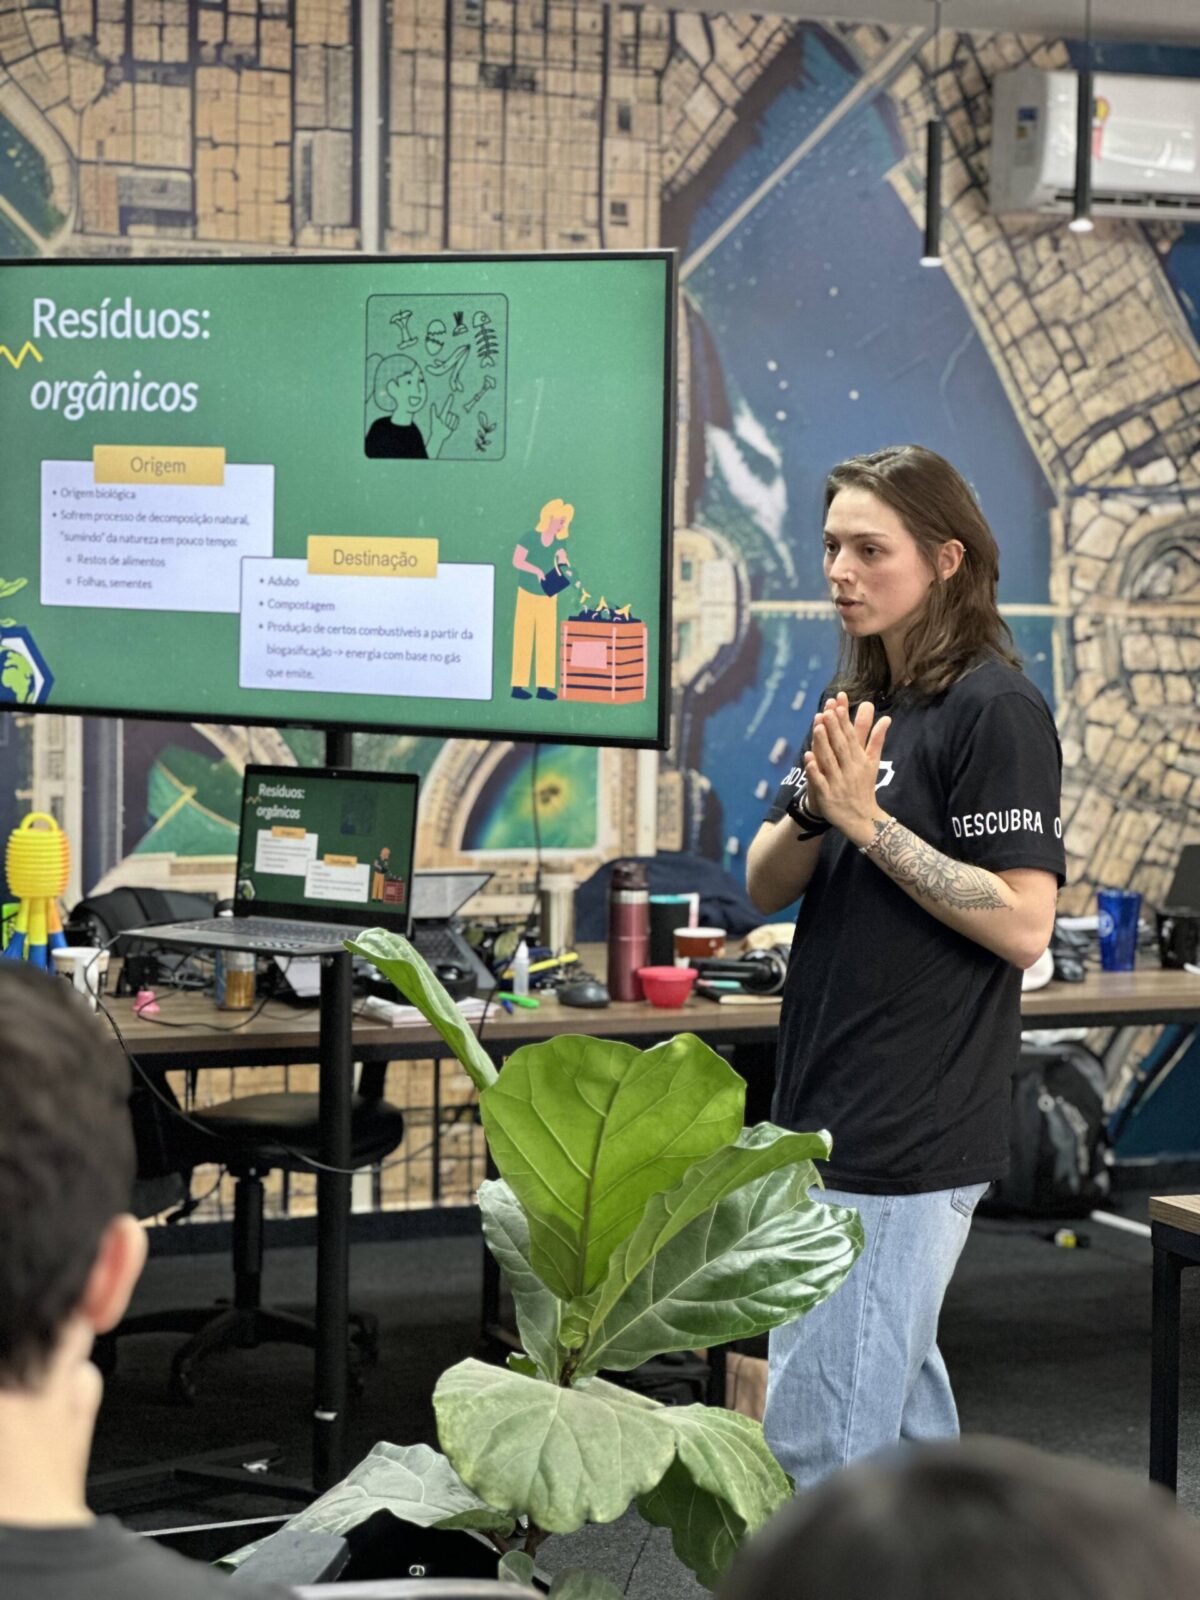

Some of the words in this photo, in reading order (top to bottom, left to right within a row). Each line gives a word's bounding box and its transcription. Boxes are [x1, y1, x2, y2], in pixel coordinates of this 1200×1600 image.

[32, 296, 211, 340] Resíduos:
[30, 369, 199, 421] orgânicos
[130, 456, 187, 477] Origem
[60, 487, 94, 501] Origem
[95, 487, 136, 501] biológica
[60, 509, 93, 521] Sofrem
[94, 512, 134, 524] processo
[135, 511, 147, 523] de
[148, 512, 214, 526] decomposição
[106, 532, 118, 544] da
[119, 534, 159, 545] natureza
[160, 537, 175, 546] em
[176, 536, 205, 548] pouco
[77, 553, 107, 566] Restos
[109, 555, 120, 567] de
[122, 555, 166, 568] alimentos
[333, 548, 418, 571] Destinação
[109, 579, 153, 590] sementes
[267, 575, 300, 588] Adubo
[267, 598, 336, 613] Compostagem
[266, 620, 313, 635] Produção
[313, 622, 326, 635] de
[327, 625, 357, 636] certos
[358, 625, 422, 639] combustíveis
[423, 629, 430, 639] a
[431, 627, 459, 641] partir
[460, 628, 474, 640] da
[266, 643, 333, 659] biogasificação
[345, 647, 382, 662] energia
[383, 650, 404, 661] com
[405, 648, 428, 661] base
[429, 652, 444, 662] no
[444, 650, 462, 665] gás
[266, 668, 284, 680] que
[258, 783, 306, 800] Resíduos:
[256, 804, 301, 820] orgânicos
[951, 808, 1044, 838] DESCUBRA
[1053, 816, 1062, 839] O
